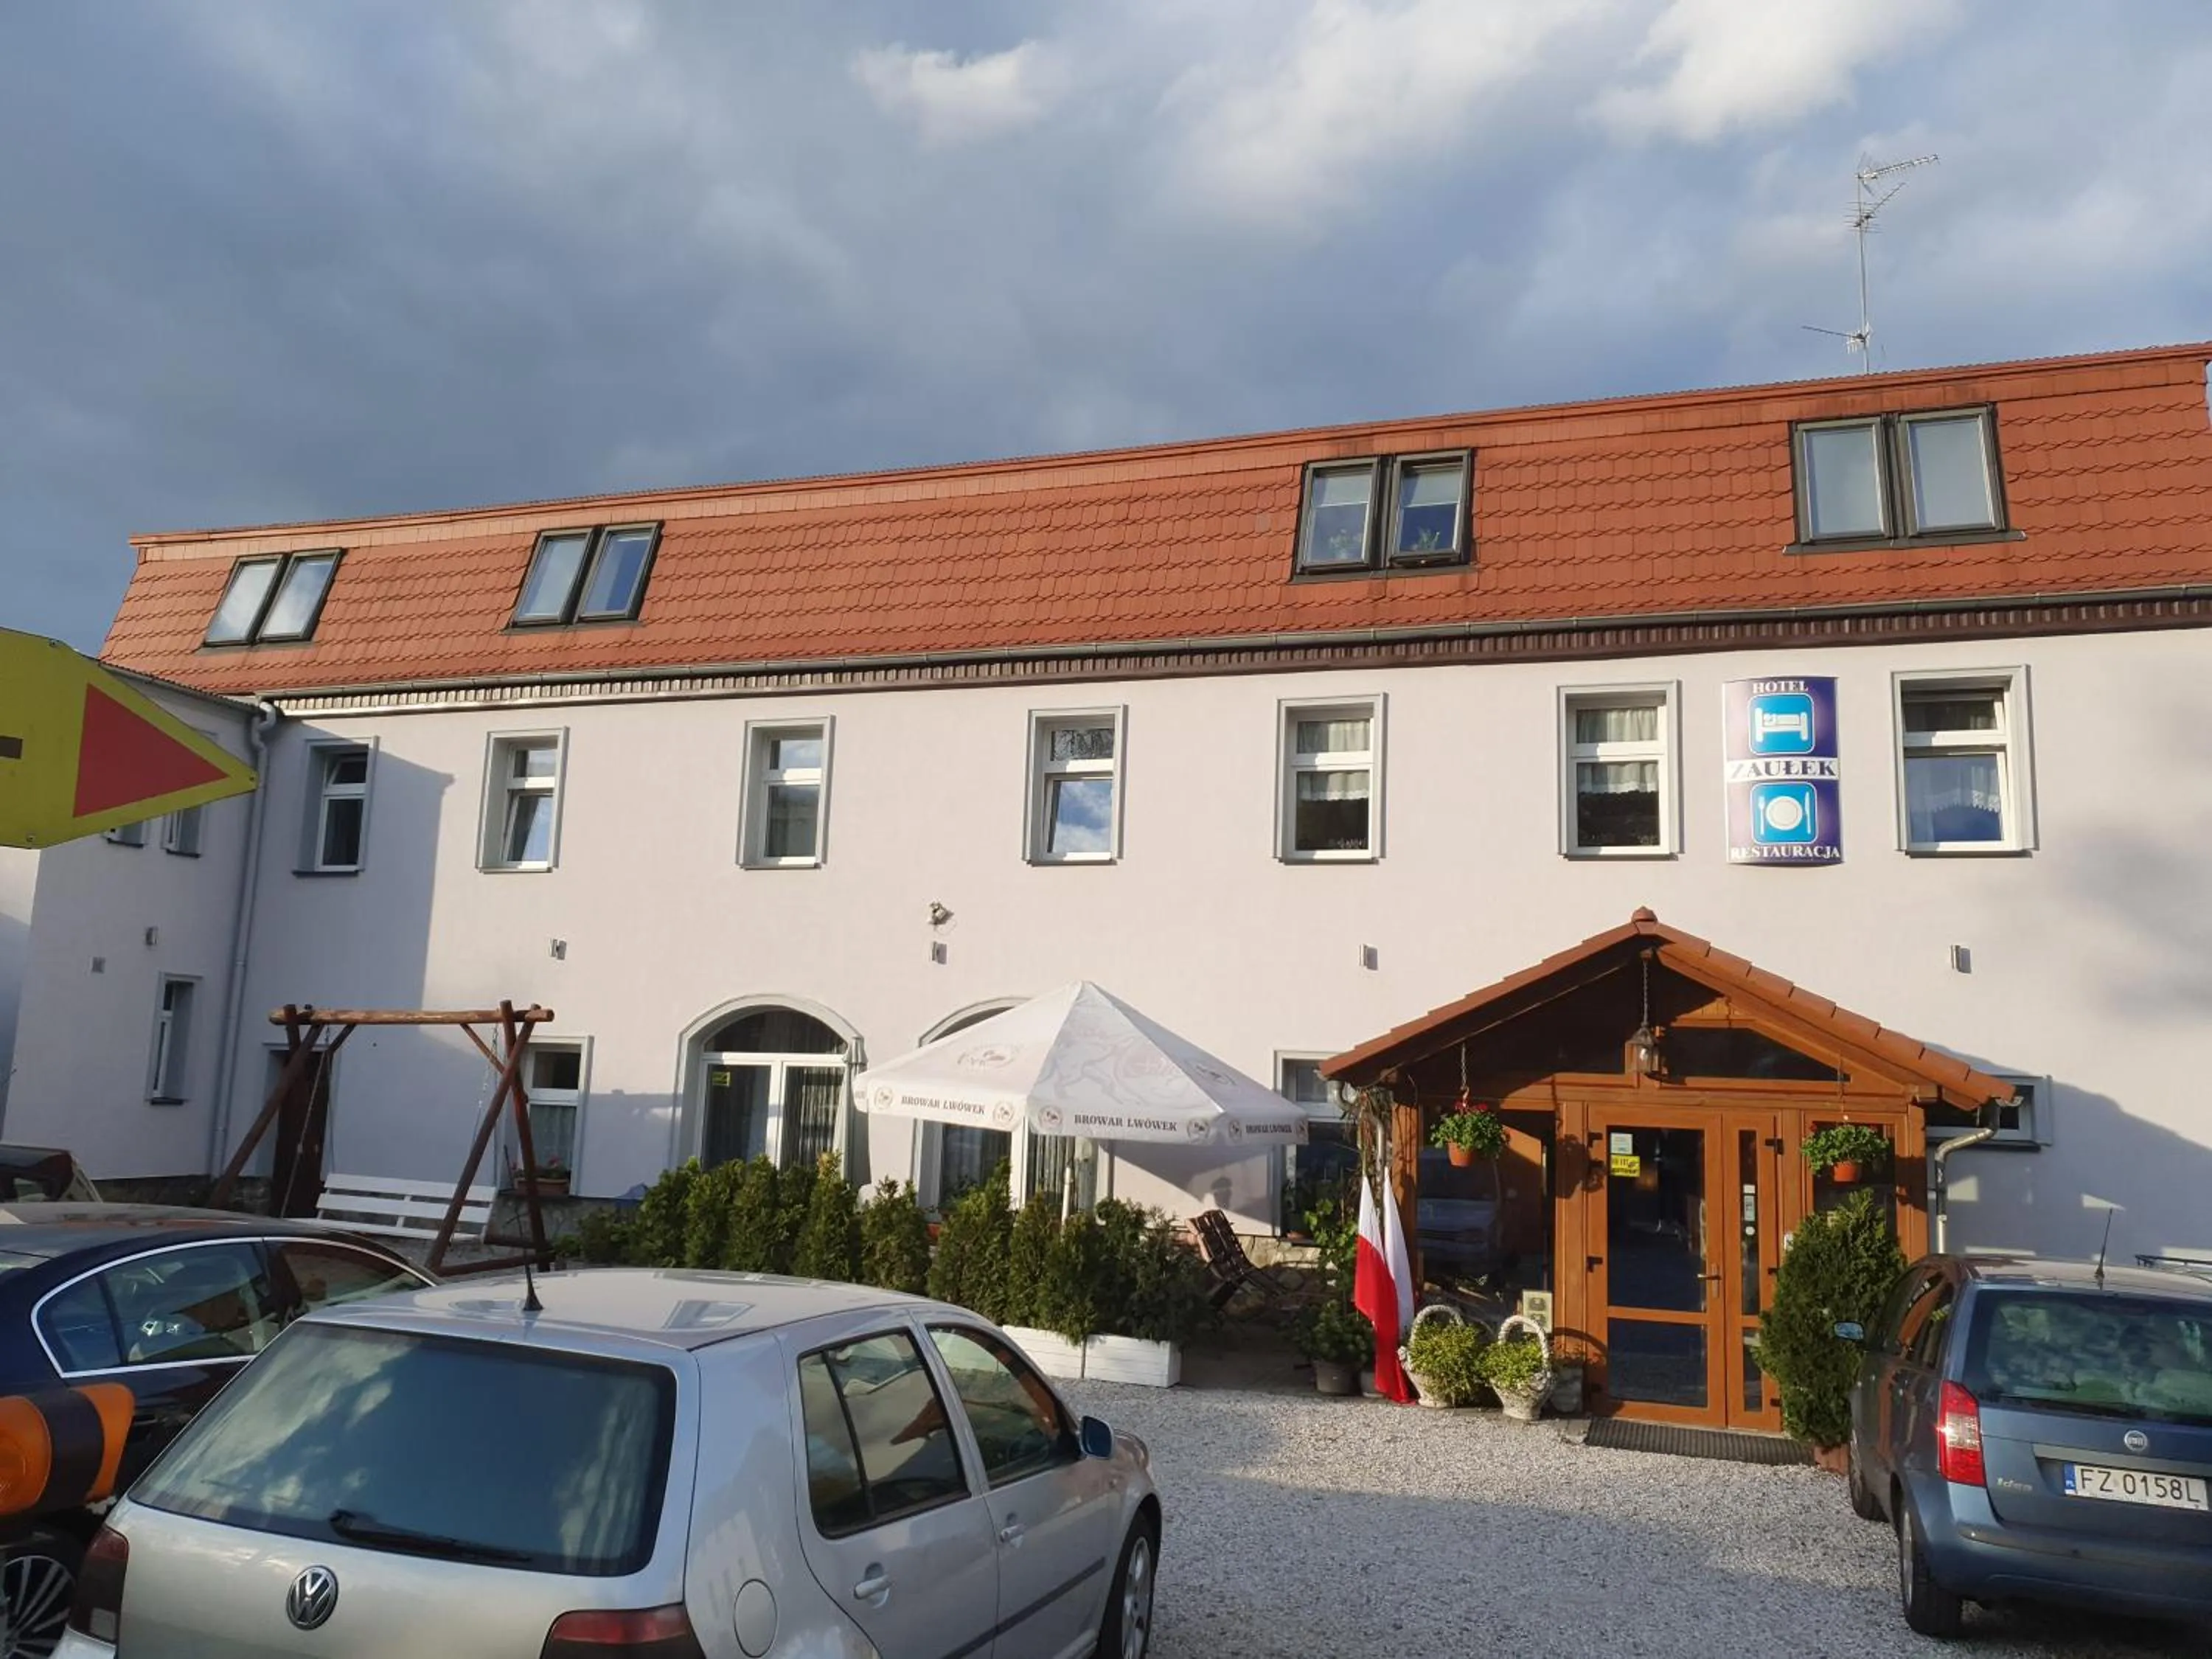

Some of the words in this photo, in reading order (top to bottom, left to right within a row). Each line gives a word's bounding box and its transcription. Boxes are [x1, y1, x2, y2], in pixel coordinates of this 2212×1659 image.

[1753, 681, 1808, 694] HOTEL
[1732, 760, 1836, 779] ZAUŁEK
[1731, 845, 1840, 860] RESTAURACJA
[901, 1095, 940, 1109] BROWAR
[1074, 1114, 1124, 1127] BROWAR
[1127, 1116, 1178, 1132] LWÓWEK
[2080, 1468, 2113, 1492] FZ
[2122, 1473, 2201, 1503] 0158L
